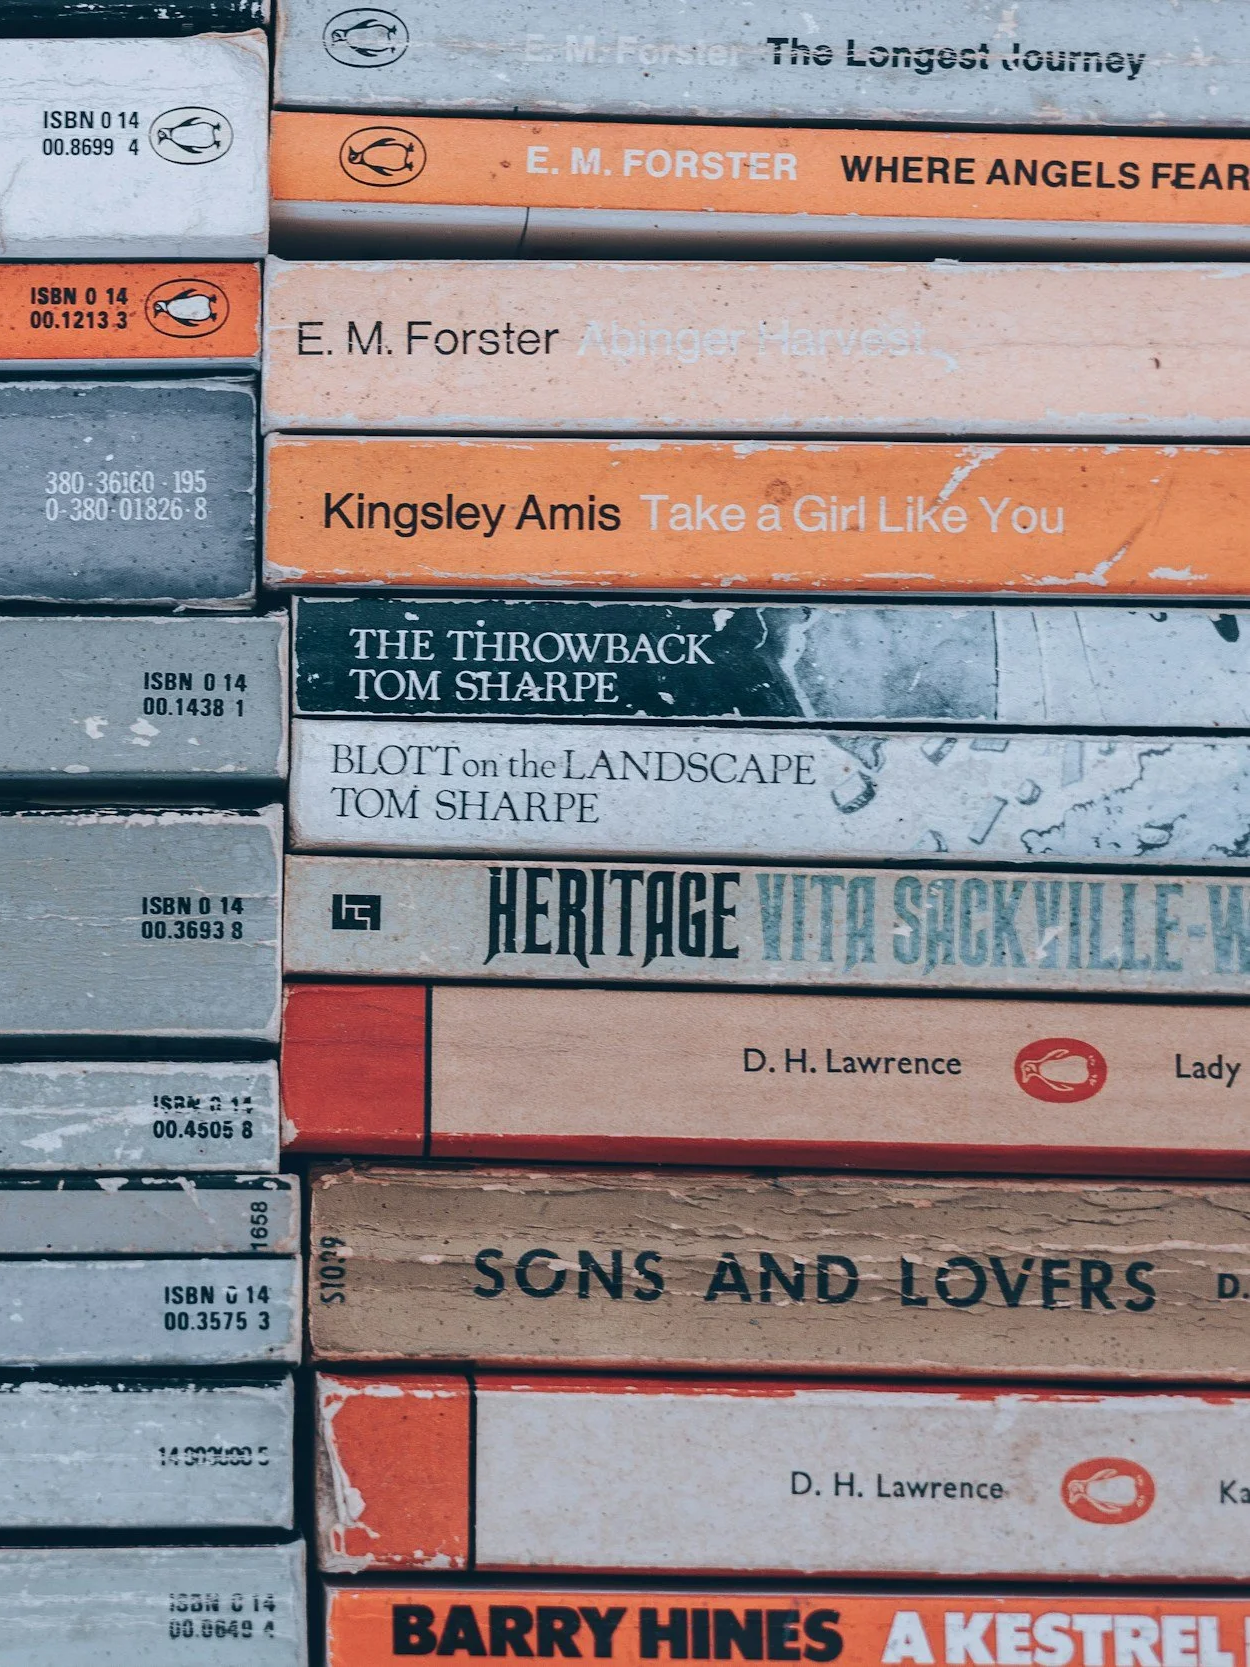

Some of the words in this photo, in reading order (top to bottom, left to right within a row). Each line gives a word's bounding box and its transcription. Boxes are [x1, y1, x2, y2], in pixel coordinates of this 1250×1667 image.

[617, 36, 740, 66] Forster
[766, 37, 834, 67] The
[846, 38, 990, 76] Longest
[1001, 42, 1146, 81] Journey
[43, 110, 94, 129] ISBN
[100, 111, 112, 129] 0
[118, 111, 140, 129] 14
[42, 137, 114, 156] 00.8699
[128, 138, 139, 156] 4
[526, 145, 559, 175] E.
[571, 147, 612, 176] M.
[623, 149, 798, 181] FORSTER
[840, 155, 976, 185] WHERE
[985, 158, 1140, 190] ANGELS
[1151, 162, 1250, 191] FEAR
[30, 286, 77, 305] ISBN
[85, 286, 97, 306] 0
[105, 287, 129, 305] 14
[30, 310, 109, 330] 00.1213
[115, 310, 128, 330] 3
[297, 321, 333, 356] E.
[347, 320, 393, 355] M.
[407, 320, 560, 356] Forster
[577, 320, 746, 364] Abinger
[758, 320, 926, 357] Harvest
[324, 492, 506, 538] Kingsley
[515, 494, 621, 532] Amis
[640, 494, 746, 531] Take
[756, 504, 781, 532] a
[793, 495, 868, 533] Girl
[879, 496, 967, 533] Like
[978, 499, 1064, 535] You
[349, 628, 435, 661] THE
[446, 629, 715, 665] THROWBACK
[144, 671, 193, 691] ISBN
[203, 672, 216, 692] 0
[223, 673, 248, 693] 14
[348, 668, 442, 702] TOM
[455, 670, 619, 703] SHARPE
[143, 696, 224, 717] 00.1438
[236, 699, 244, 717] 1
[332, 744, 461, 777] BLOTT
[462, 758, 499, 778] on
[508, 748, 557, 779] the
[563, 749, 816, 786] LANDSCAPE
[330, 786, 420, 819] TOM
[435, 789, 599, 824] SHARPE
[142, 896, 192, 916] ISBN
[198, 896, 211, 915] 0
[220, 896, 244, 915] 14
[482, 866, 741, 969] HERITAGE
[755, 871, 876, 968] VITA
[141, 920, 225, 940] 00.3693
[231, 920, 243, 940] 8
[743, 1047, 776, 1073] D.
[785, 1048, 817, 1074] H.
[826, 1048, 962, 1076] Lawrence
[1175, 1053, 1242, 1089] Lady
[152, 1119, 234, 1140] 00.4505
[241, 1120, 253, 1140] 8
[250, 1201, 268, 1249] 1658
[164, 1285, 215, 1305] ISBN
[225, 1285, 238, 1305] 0
[246, 1285, 270, 1304] 14
[474, 1249, 664, 1301] SONS
[704, 1252, 858, 1304] AND
[901, 1257, 1157, 1312] LOVERS
[1217, 1273, 1250, 1299] D.
[164, 1311, 248, 1331] 00.3575
[258, 1311, 270, 1331] 3
[791, 1470, 821, 1497] D.
[834, 1472, 863, 1498] H.
[877, 1473, 1005, 1500] Lawrence
[392, 1604, 627, 1659] BARRY
[638, 1607, 844, 1663] HINES
[881, 1611, 935, 1665] A
[945, 1612, 1234, 1667] KESTREL
